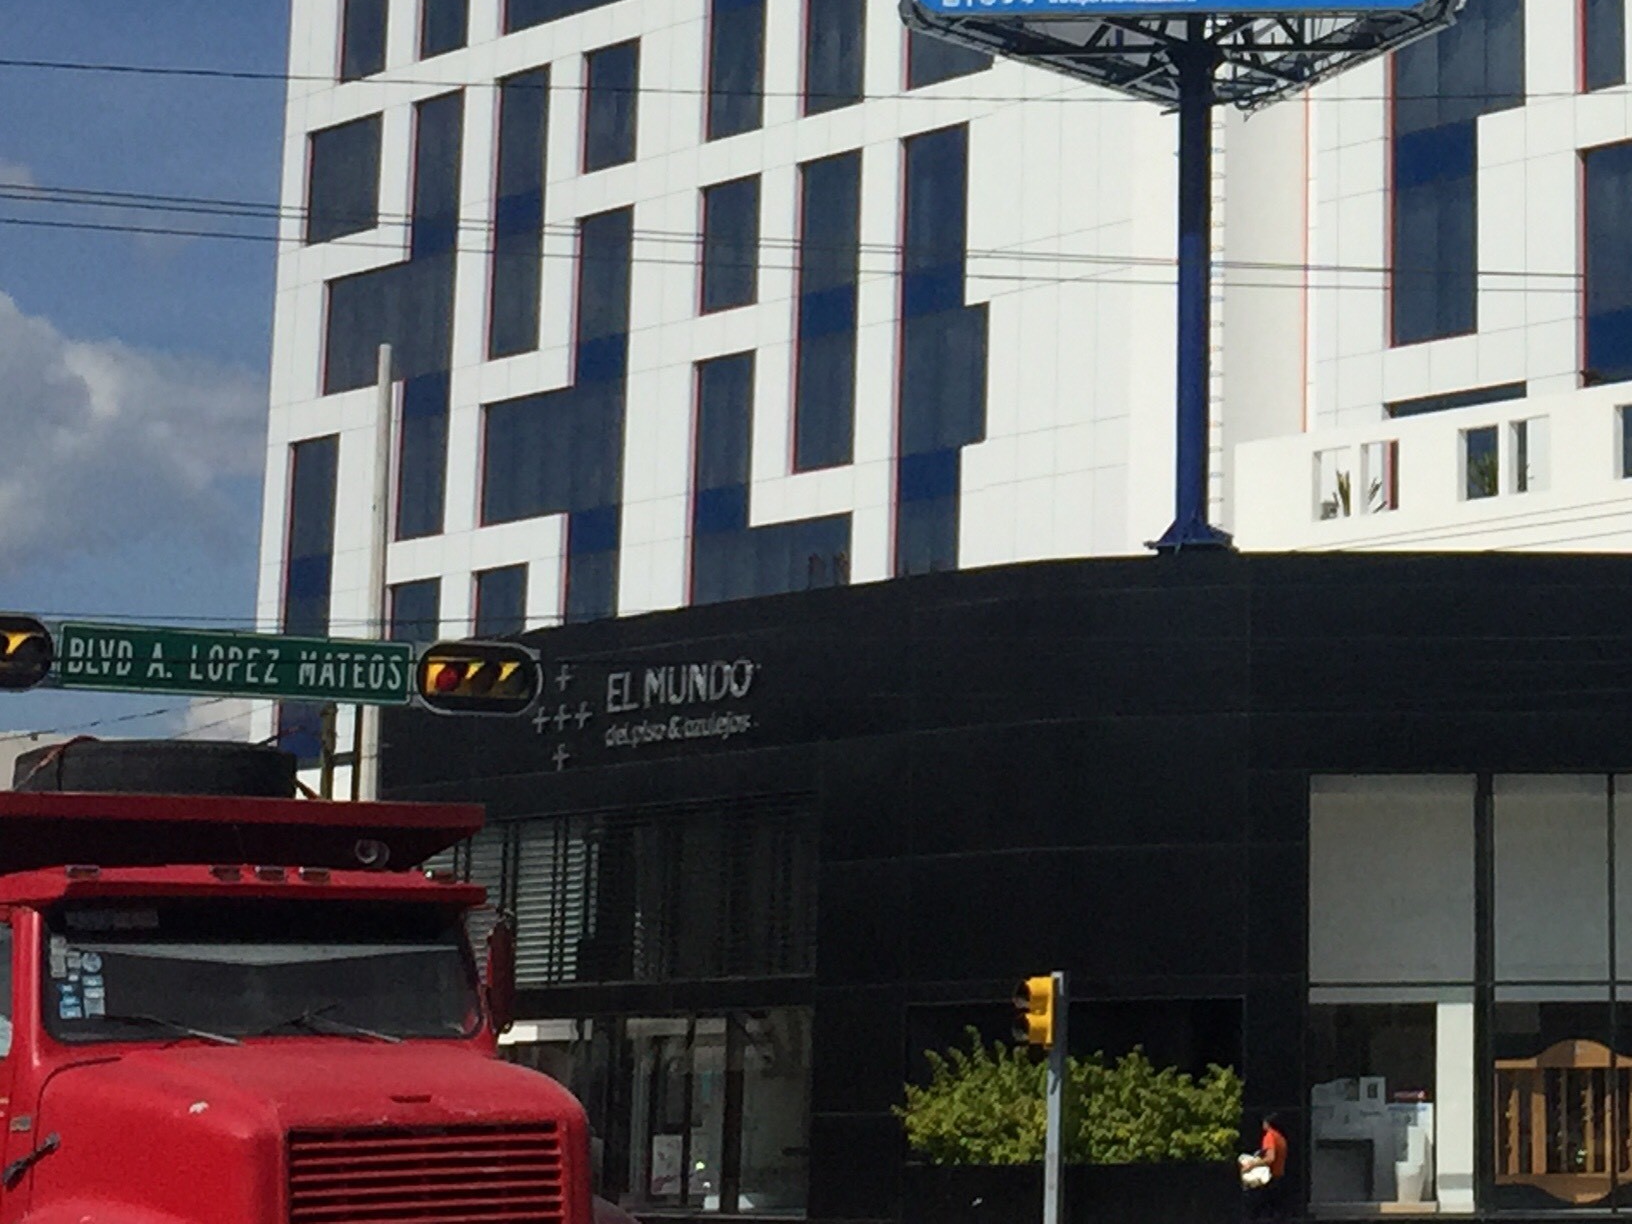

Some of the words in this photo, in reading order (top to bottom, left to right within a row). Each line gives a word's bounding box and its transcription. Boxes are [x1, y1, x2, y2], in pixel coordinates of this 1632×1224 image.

[68, 637, 134, 676] BLVD
[147, 642, 173, 679] A.
[189, 644, 281, 684] LOPEZ
[298, 650, 403, 691] MATEOS
[606, 672, 639, 713] EL
[644, 659, 755, 709] MUNDO
